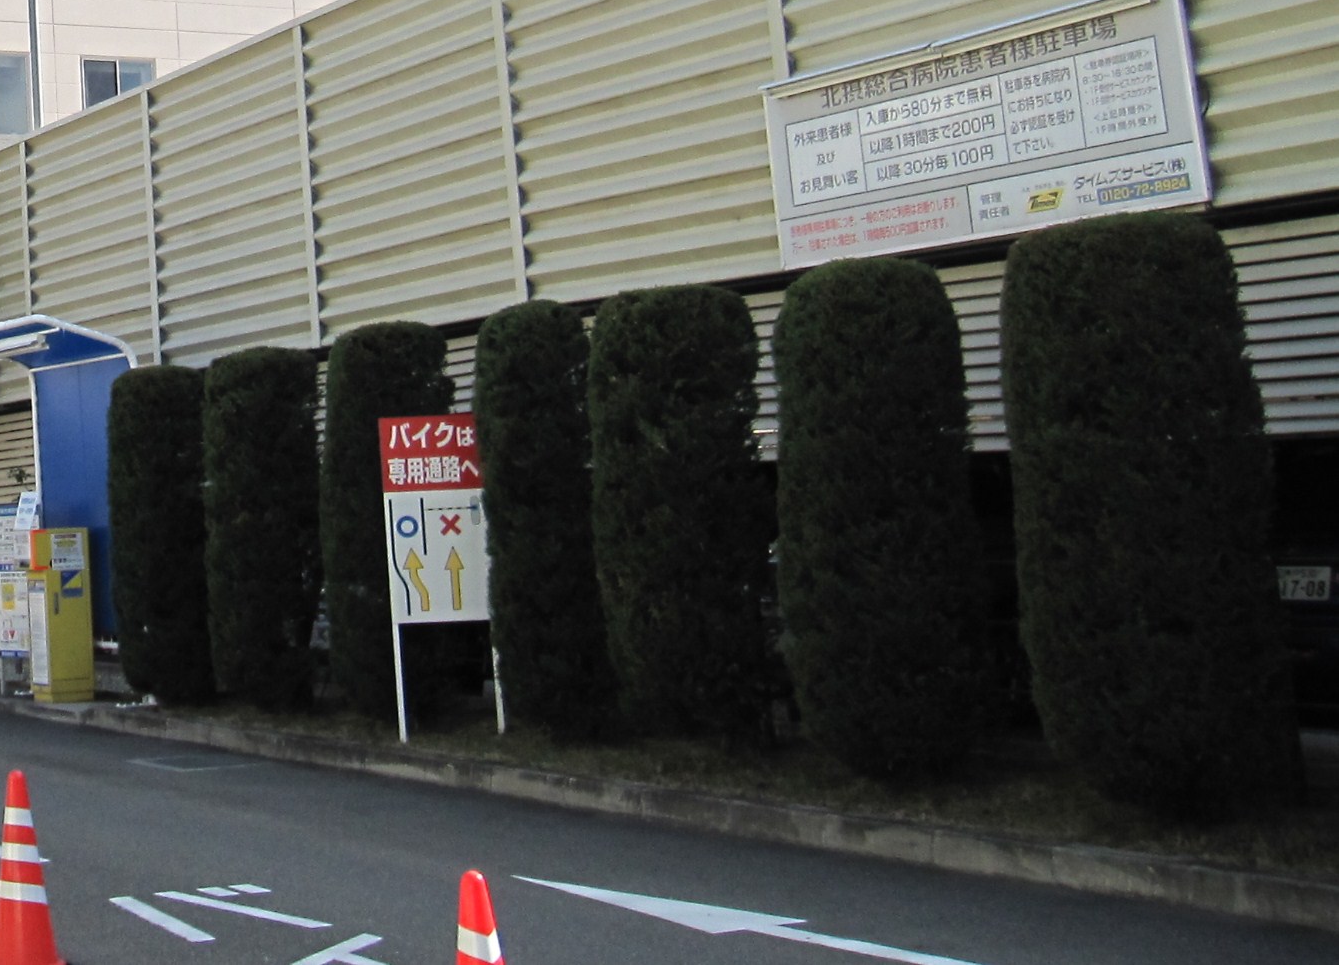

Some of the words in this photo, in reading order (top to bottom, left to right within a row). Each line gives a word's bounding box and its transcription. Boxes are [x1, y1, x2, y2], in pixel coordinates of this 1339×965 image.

[822, 15, 1117, 109] 北摂総合病院患者様駐車場
[1007, 88, 1073, 112] にお持ちになり
[794, 122, 852, 147] 外来患者様
[869, 114, 995, 154] 以降1時間まで200円
[817, 151, 835, 166] 及び
[980, 191, 1002, 205] 管理
[979, 204, 1010, 221] 責任者
[389, 422, 475, 449] バイクは
[388, 455, 480, 485] 専用通路へ
